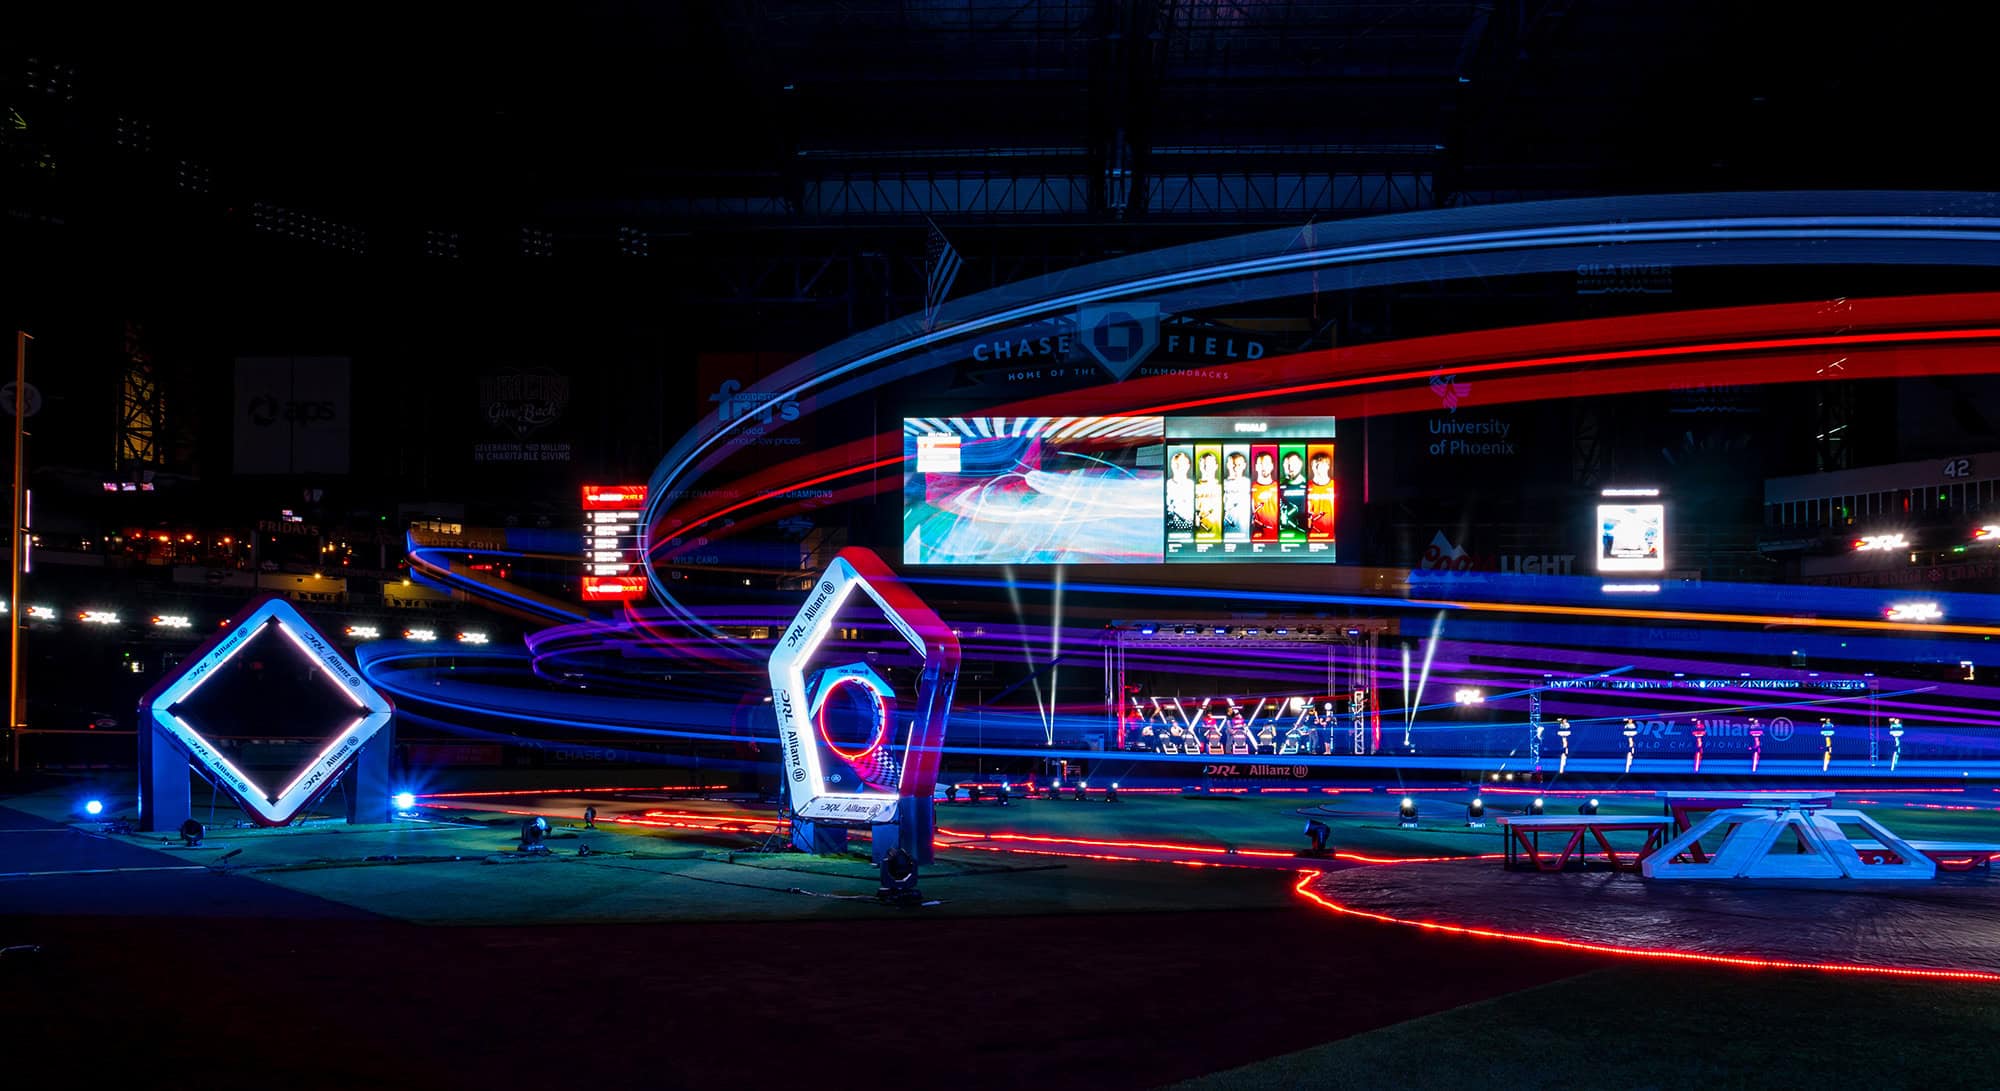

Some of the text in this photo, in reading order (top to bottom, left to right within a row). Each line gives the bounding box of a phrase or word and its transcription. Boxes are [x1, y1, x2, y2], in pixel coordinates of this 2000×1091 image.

[973, 334, 1264, 362] CHASE FIELD
[1008, 367, 1229, 382] HOME OF THE DIAMONDBACKS
[1429, 418, 1511, 439] University
[1430, 439, 1515, 456] of Phoenix
[1944, 459, 1970, 478] 42
[786, 488, 833, 499] CHAMPIONS
[1500, 553, 1576, 577] LIGHT
[804, 592, 828, 622] Allianz
[214, 636, 238, 659] Allianz
[327, 655, 352, 679] Allianz
[780, 690, 794, 724] DRL
[787, 730, 801, 768] Allianz
[327, 744, 350, 768] Allianz
[213, 760, 238, 785] Allianz
[1207, 764, 1291, 777] DRL Allianz
